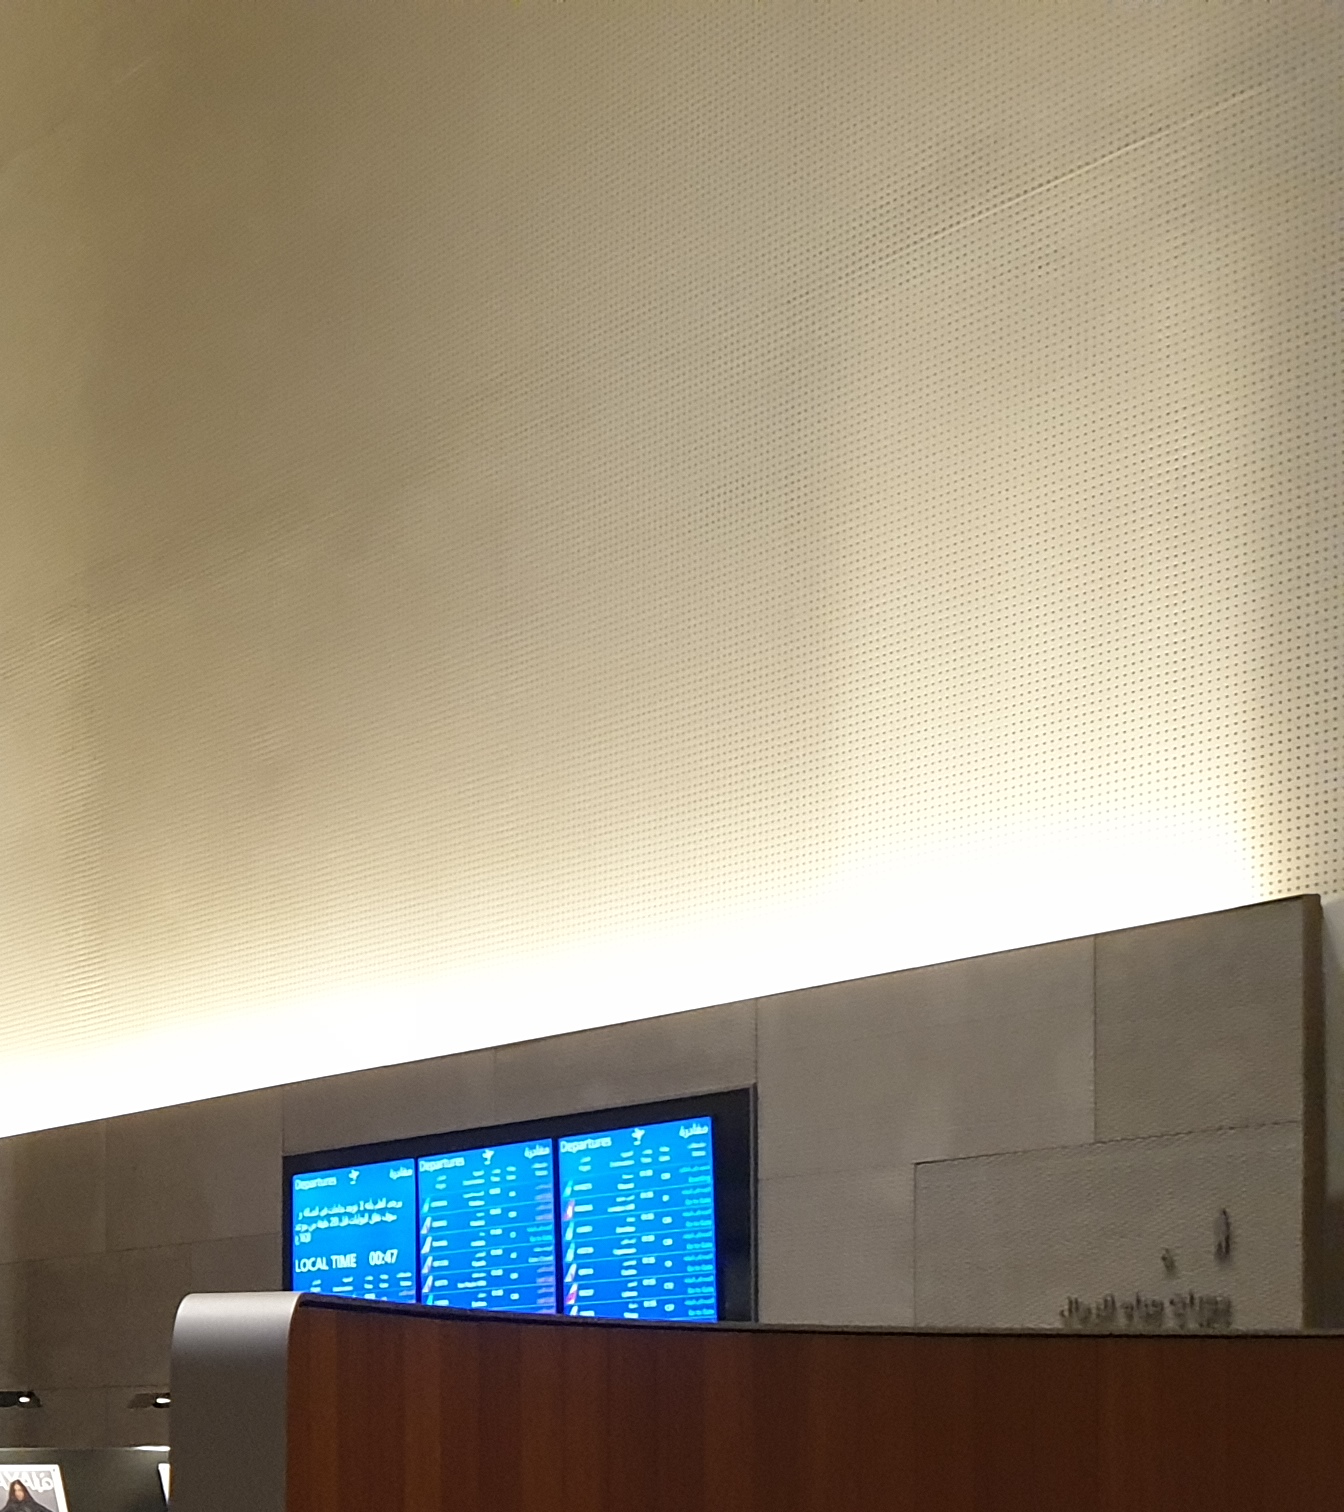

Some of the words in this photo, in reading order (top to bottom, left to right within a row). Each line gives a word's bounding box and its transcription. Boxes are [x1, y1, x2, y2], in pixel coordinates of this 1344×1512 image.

[560, 1137, 612, 1153] Departures
[419, 1157, 465, 1172] Departures
[294, 1177, 337, 1190] Departures
[295, 1257, 329, 1272] LOCAL
[331, 1253, 357, 1269] TIME
[369, 1249, 398, 1266] 00:47
